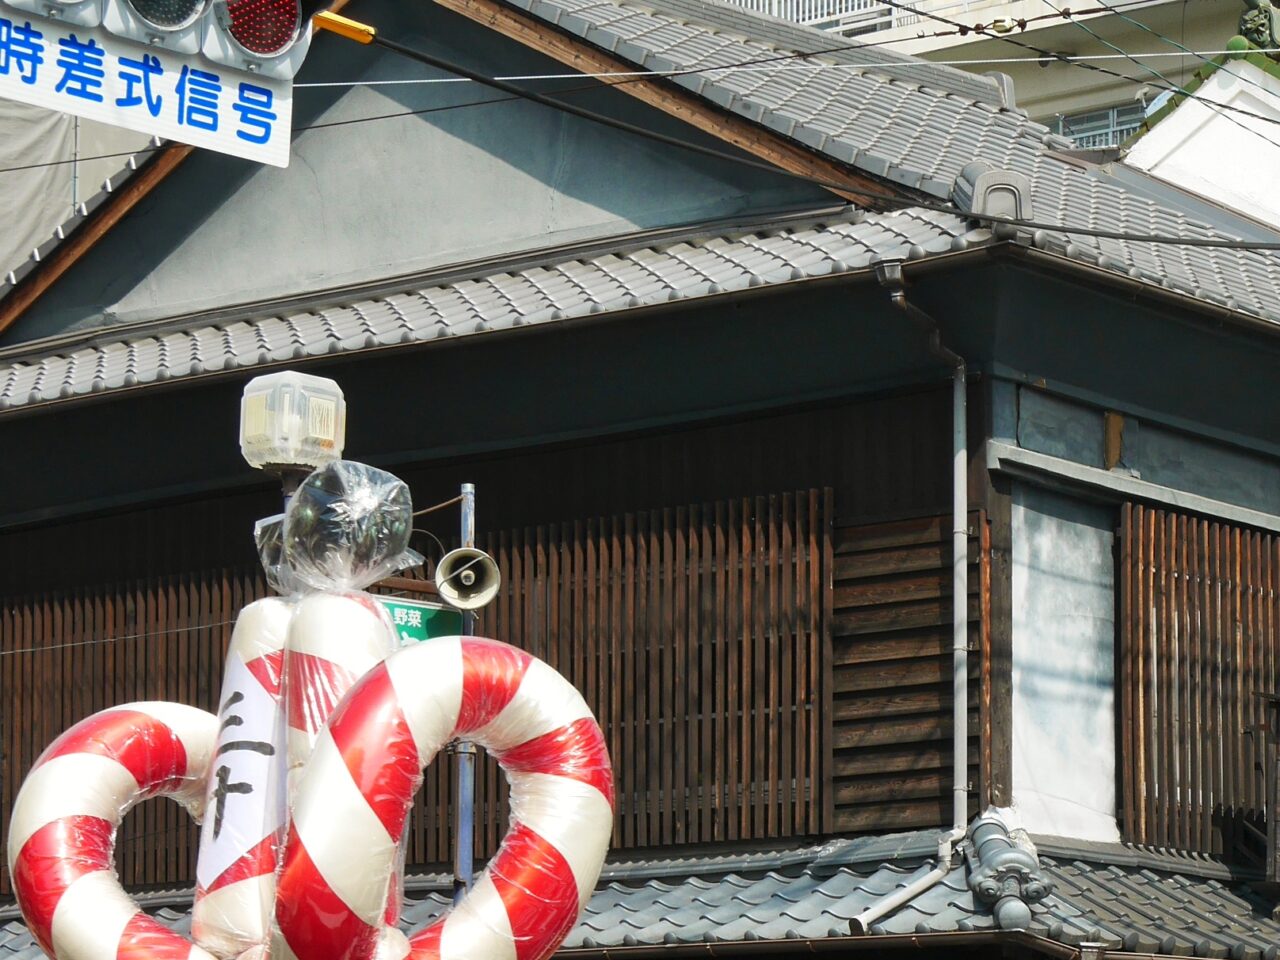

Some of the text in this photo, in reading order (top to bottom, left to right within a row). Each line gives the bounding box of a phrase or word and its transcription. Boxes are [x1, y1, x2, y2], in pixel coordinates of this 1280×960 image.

[0, 17, 278, 145] 時差式信号
[393, 608, 422, 628] 野菜
